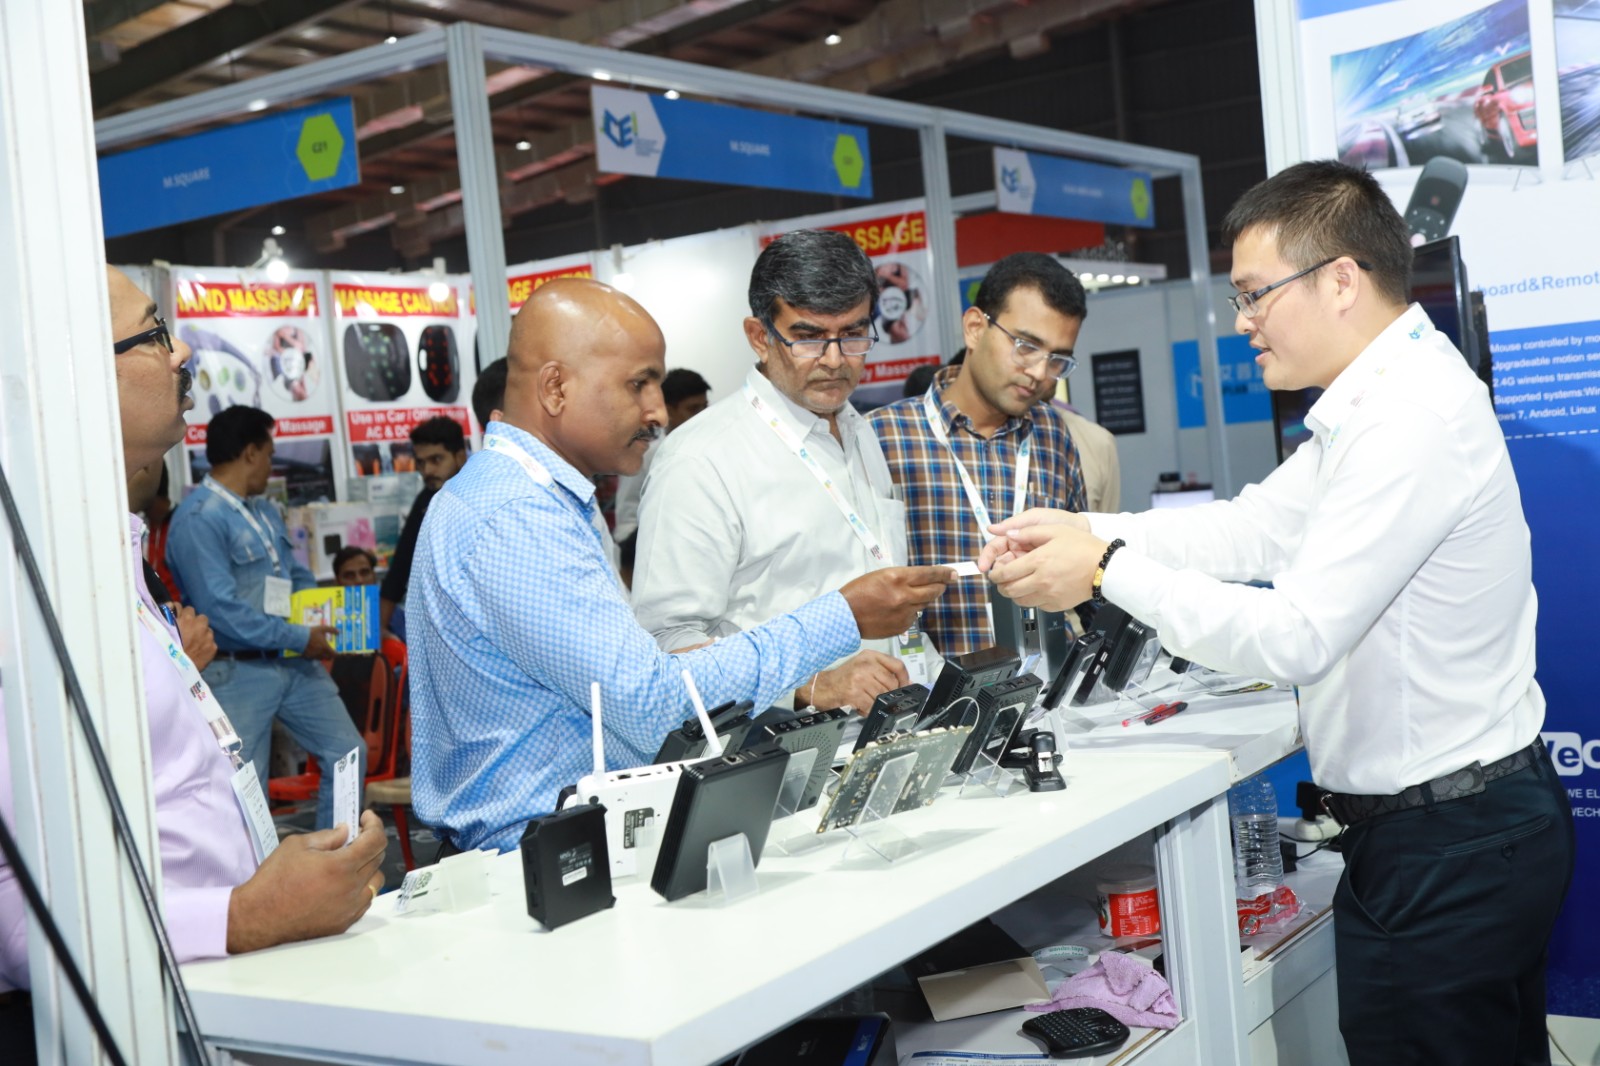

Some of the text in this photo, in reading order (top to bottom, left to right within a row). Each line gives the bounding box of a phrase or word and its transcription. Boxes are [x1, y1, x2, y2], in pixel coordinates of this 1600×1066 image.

[1490, 343, 1521, 353] Mouse
[1522, 337, 1569, 350] controlled
[1570, 335, 1583, 346] by
[1552, 354, 1584, 364] motion
[1493, 376, 1515, 388] 2.4G
[1517, 374, 1555, 385] wireless
[1494, 392, 1541, 405] Supported
[1570, 405, 1596, 415] Linux
[279, 419, 326, 436] Massage
